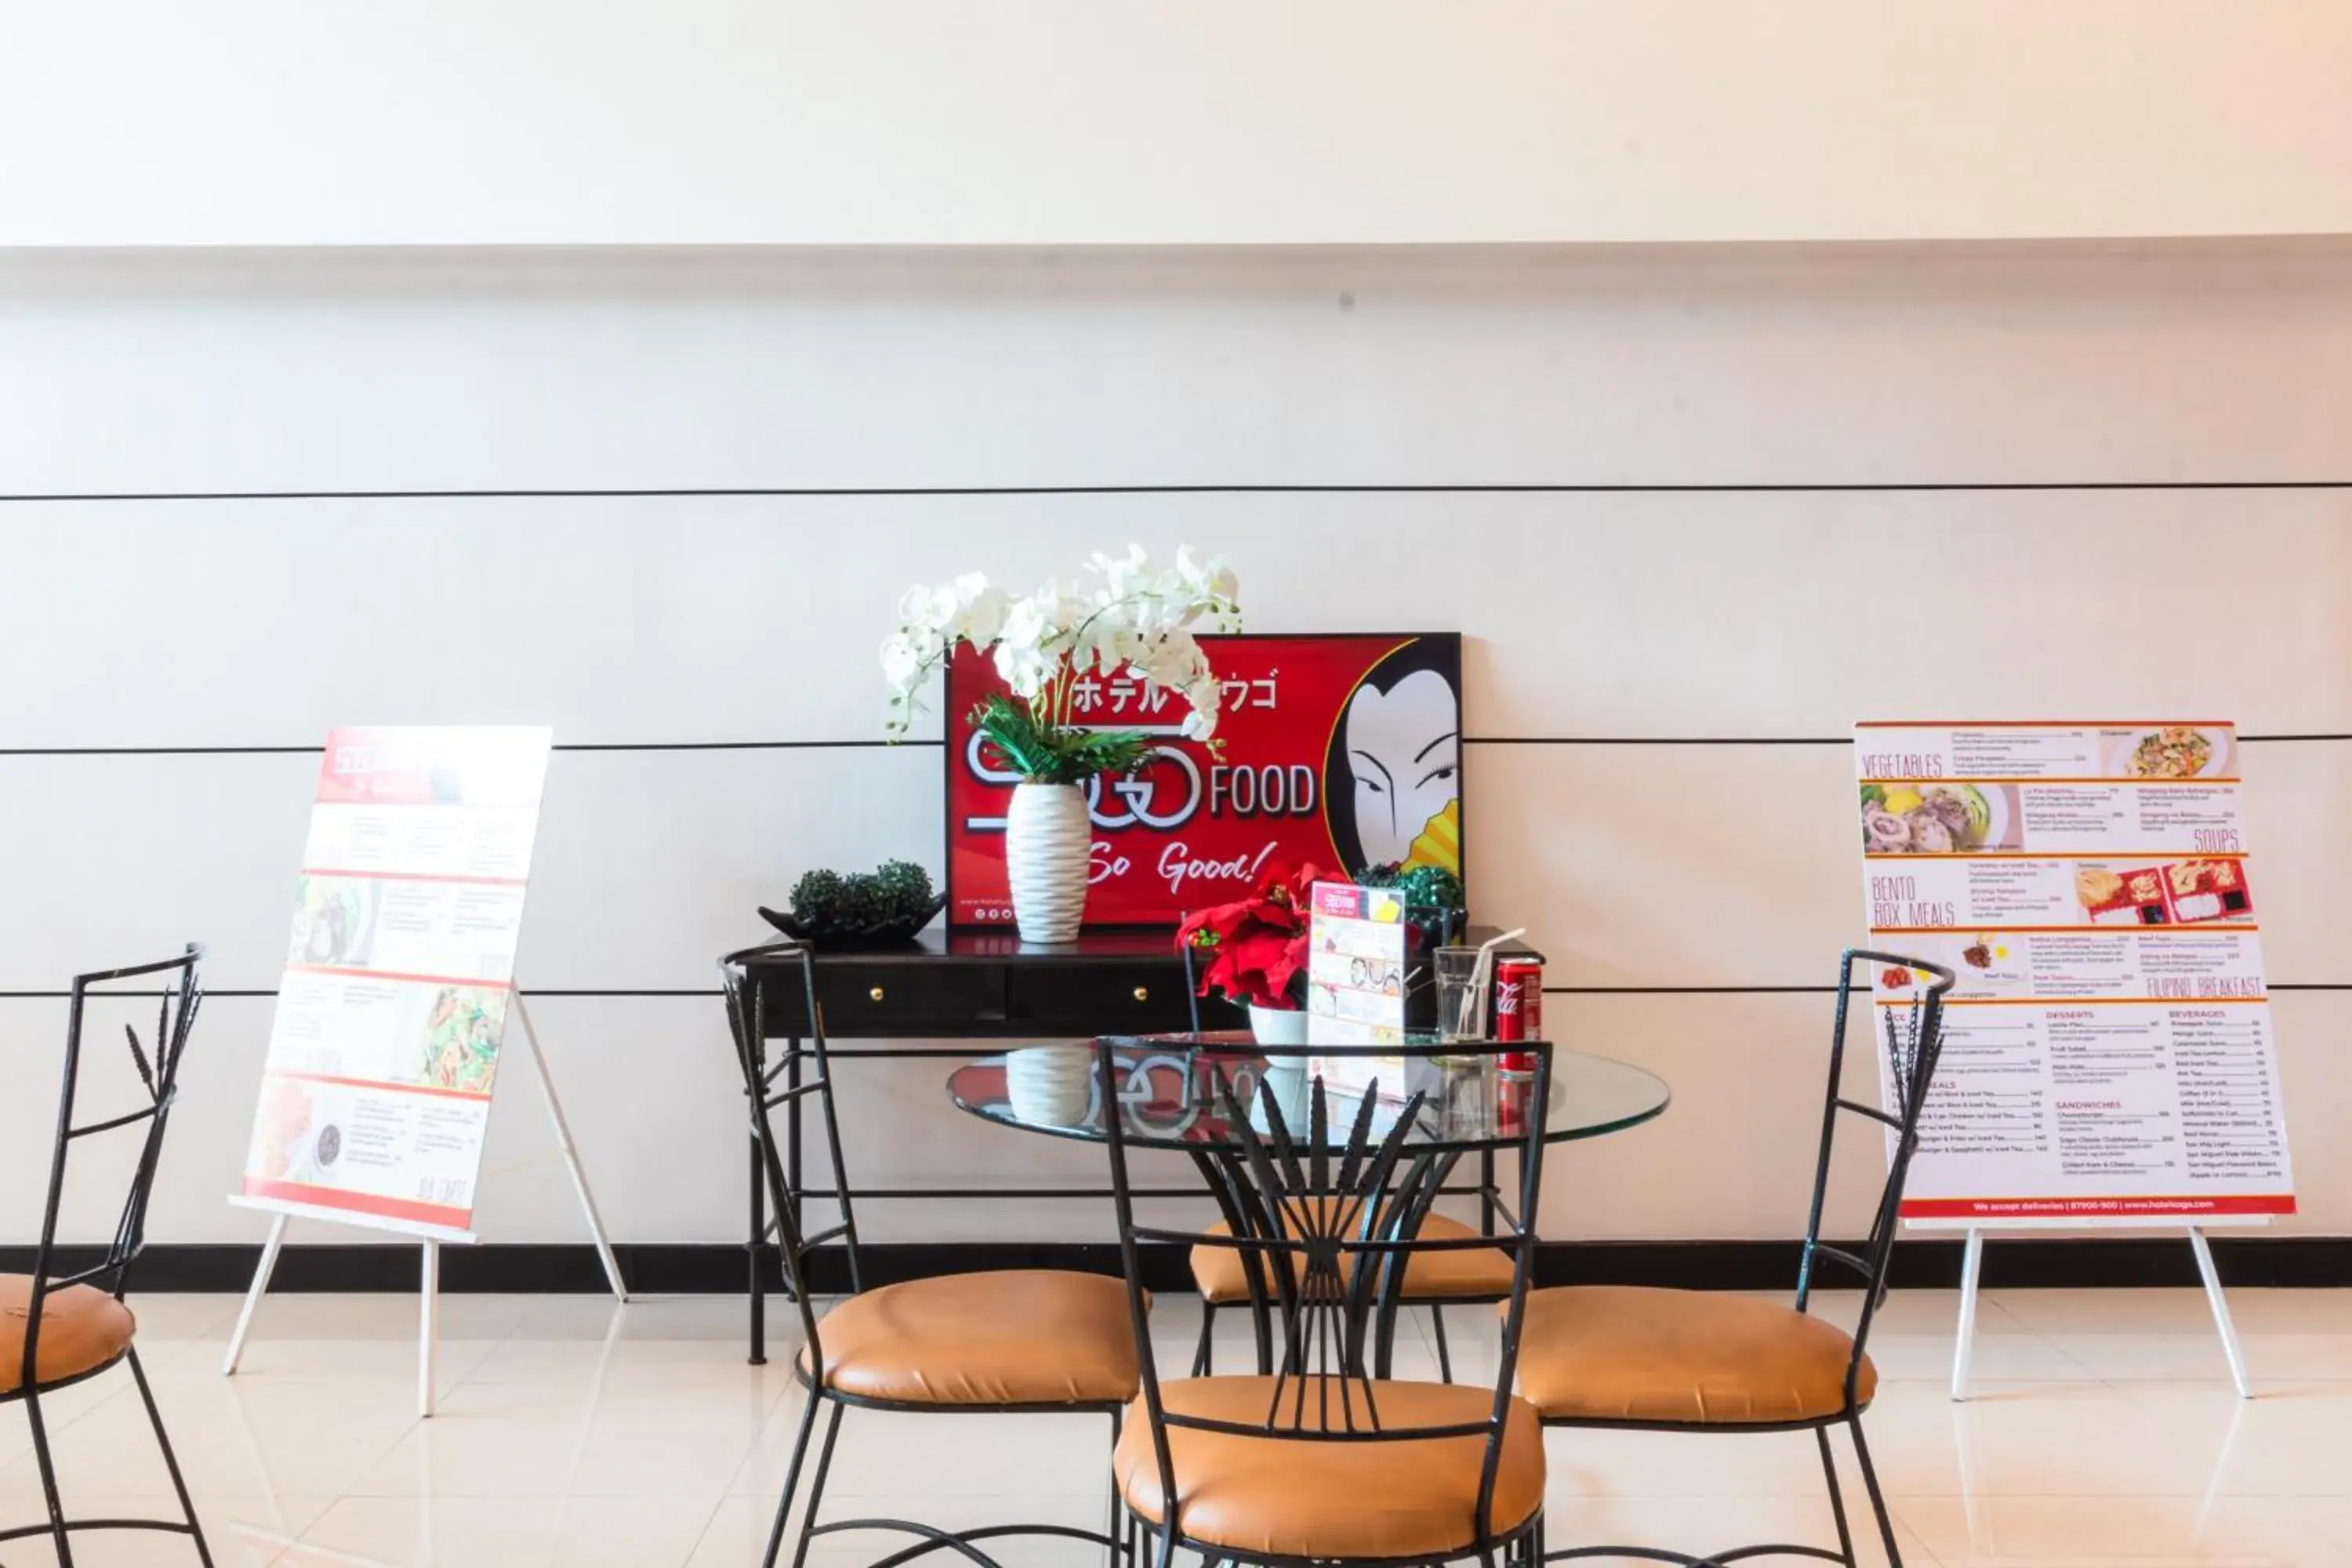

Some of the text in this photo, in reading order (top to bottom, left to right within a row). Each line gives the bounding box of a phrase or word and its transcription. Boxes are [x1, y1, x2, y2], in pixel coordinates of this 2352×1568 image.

[1074, 669, 1279, 713] ホテルウゴ
[1863, 753, 1943, 778] VEGETABLES
[1210, 764, 1315, 813] FOOD
[2194, 829, 2239, 853] SOUPS
[1085, 840, 1278, 894] So Good!
[1872, 876, 1915, 900] BENTO
[1875, 902, 1900, 927] BOX
[1909, 902, 1955, 927] MEALS
[2147, 977, 2192, 997] FILIPINO
[2197, 976, 2261, 997] BREAKFAST
[2045, 1011, 2095, 1019] DESSERTS
[2169, 1010, 2227, 1018] BEVERAGES
[2056, 1101, 2122, 1110] SANDWICHES
[1973, 1203, 1989, 1211] We
[1991, 1203, 2021, 1213] accept
[2022, 1201, 2064, 1210] deliveries
